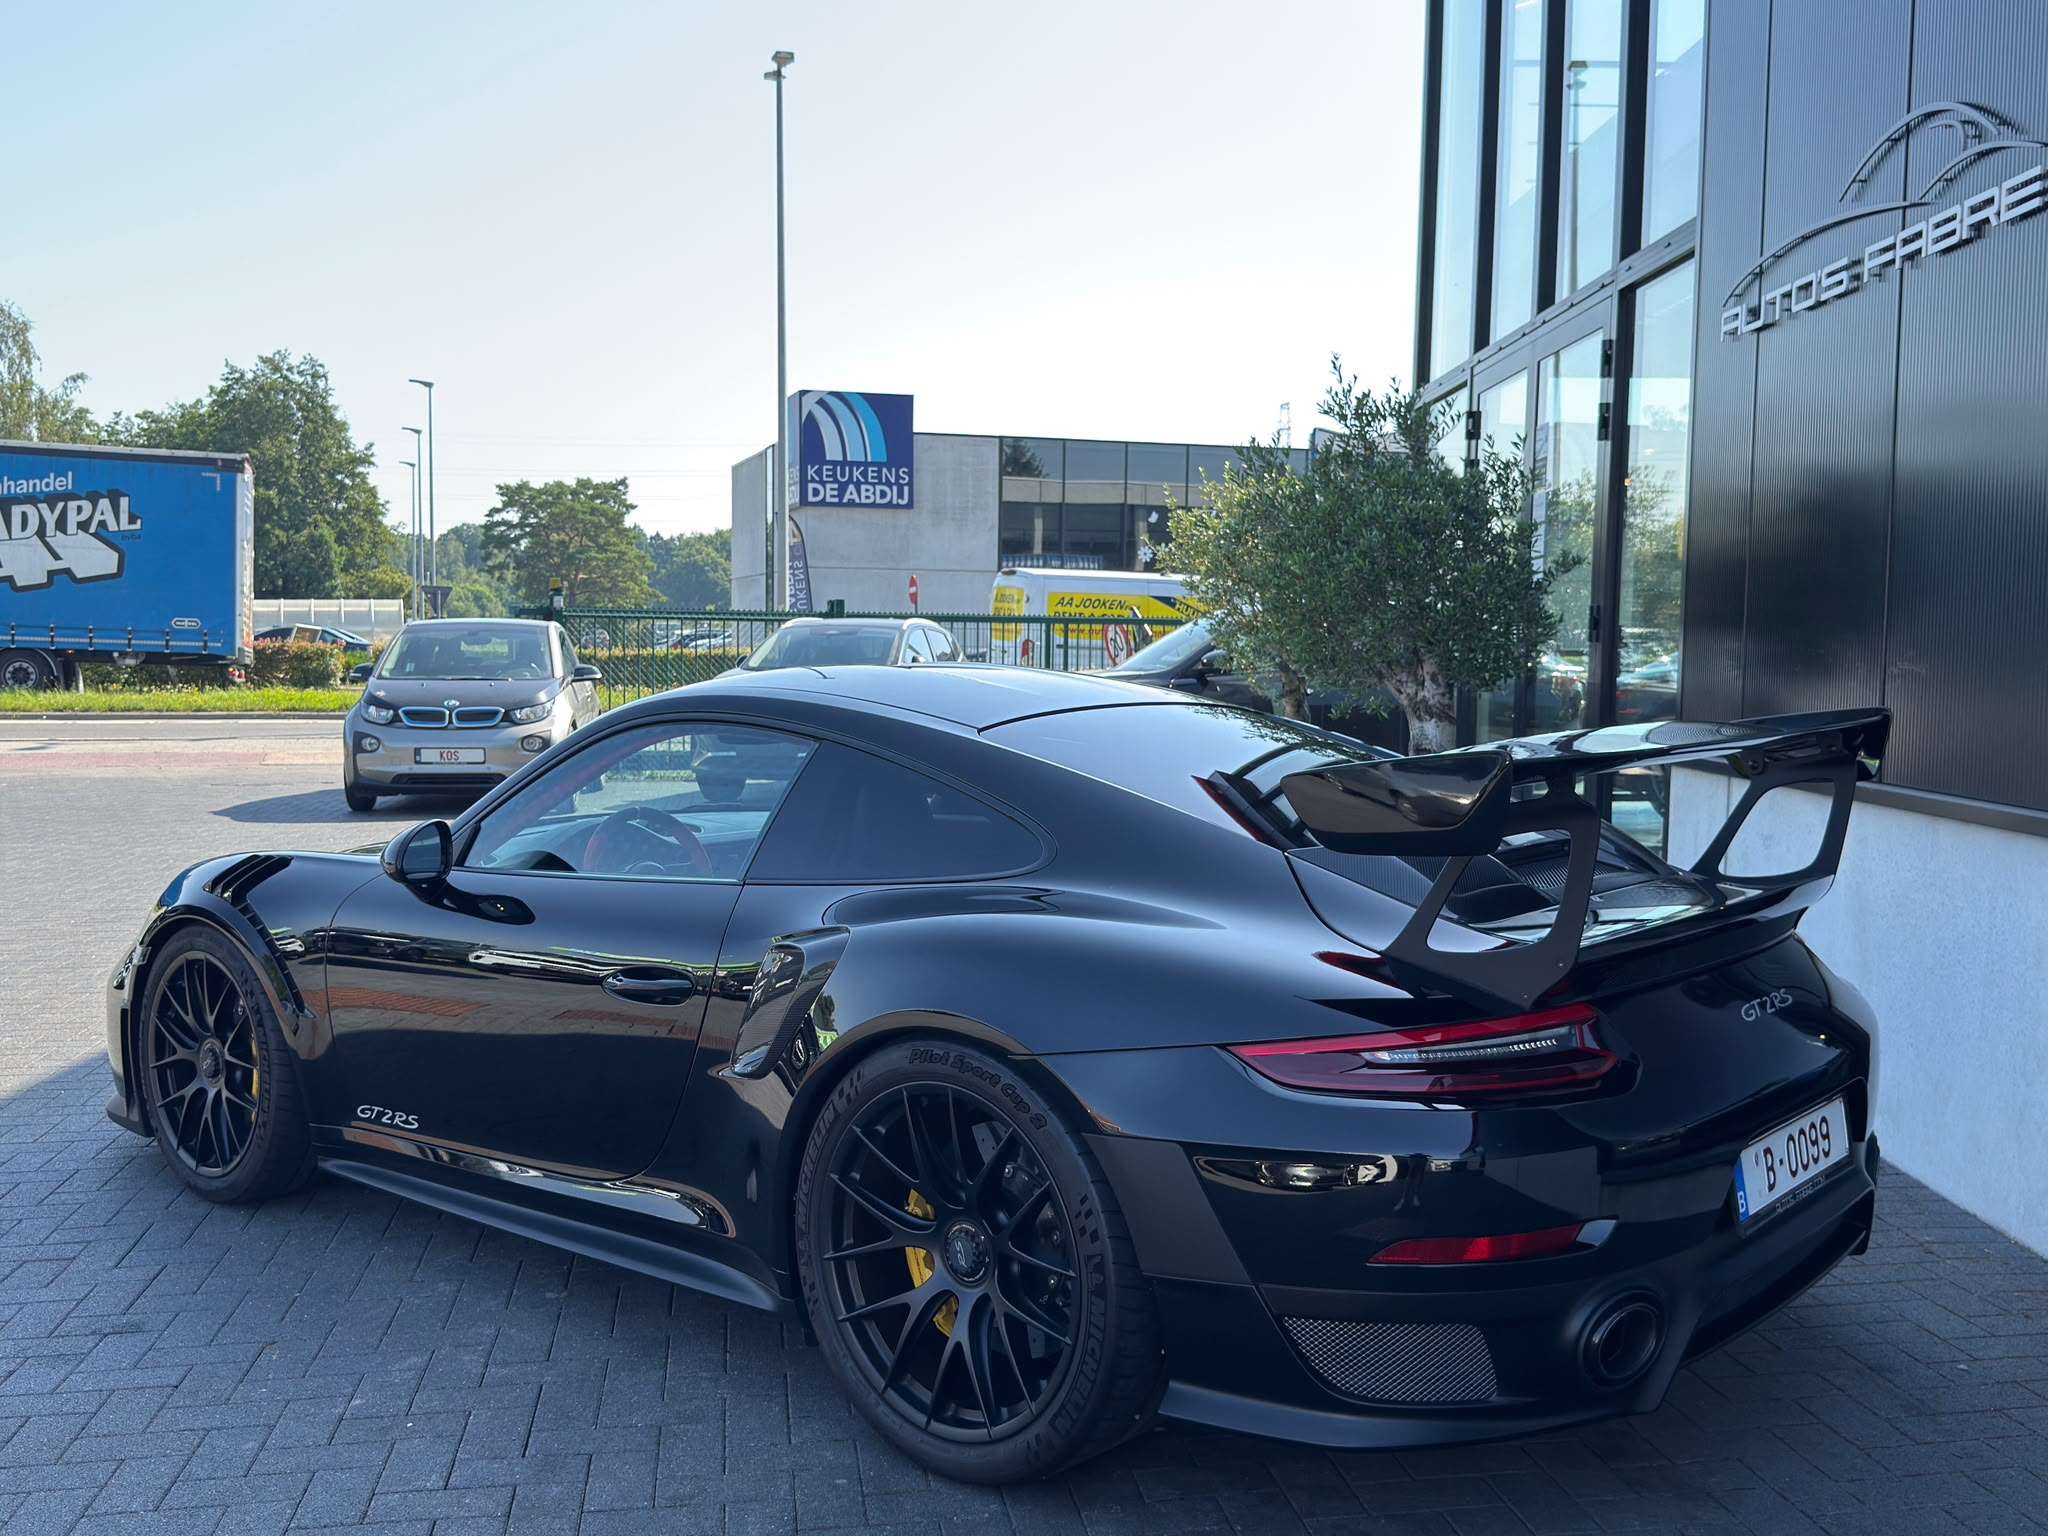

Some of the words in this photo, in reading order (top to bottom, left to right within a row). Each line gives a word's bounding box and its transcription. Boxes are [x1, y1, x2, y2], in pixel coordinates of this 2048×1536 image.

[1720, 256, 1849, 343] AUTO'S
[1863, 164, 2044, 284] FABRE
[0, 471, 73, 495] handel
[808, 464, 909, 484] KEUKENS
[807, 483, 840, 503] DE
[842, 484, 909, 505] ABDIJ
[1056, 596, 1074, 607] AA
[1075, 599, 1127, 611] JOOKEN
[440, 750, 460, 761] KOS
[909, 1048, 950, 1066] Pilot
[950, 1054, 1001, 1088] Sport
[1001, 1082, 1031, 1114] Cup
[1737, 1191, 1746, 1213] B
